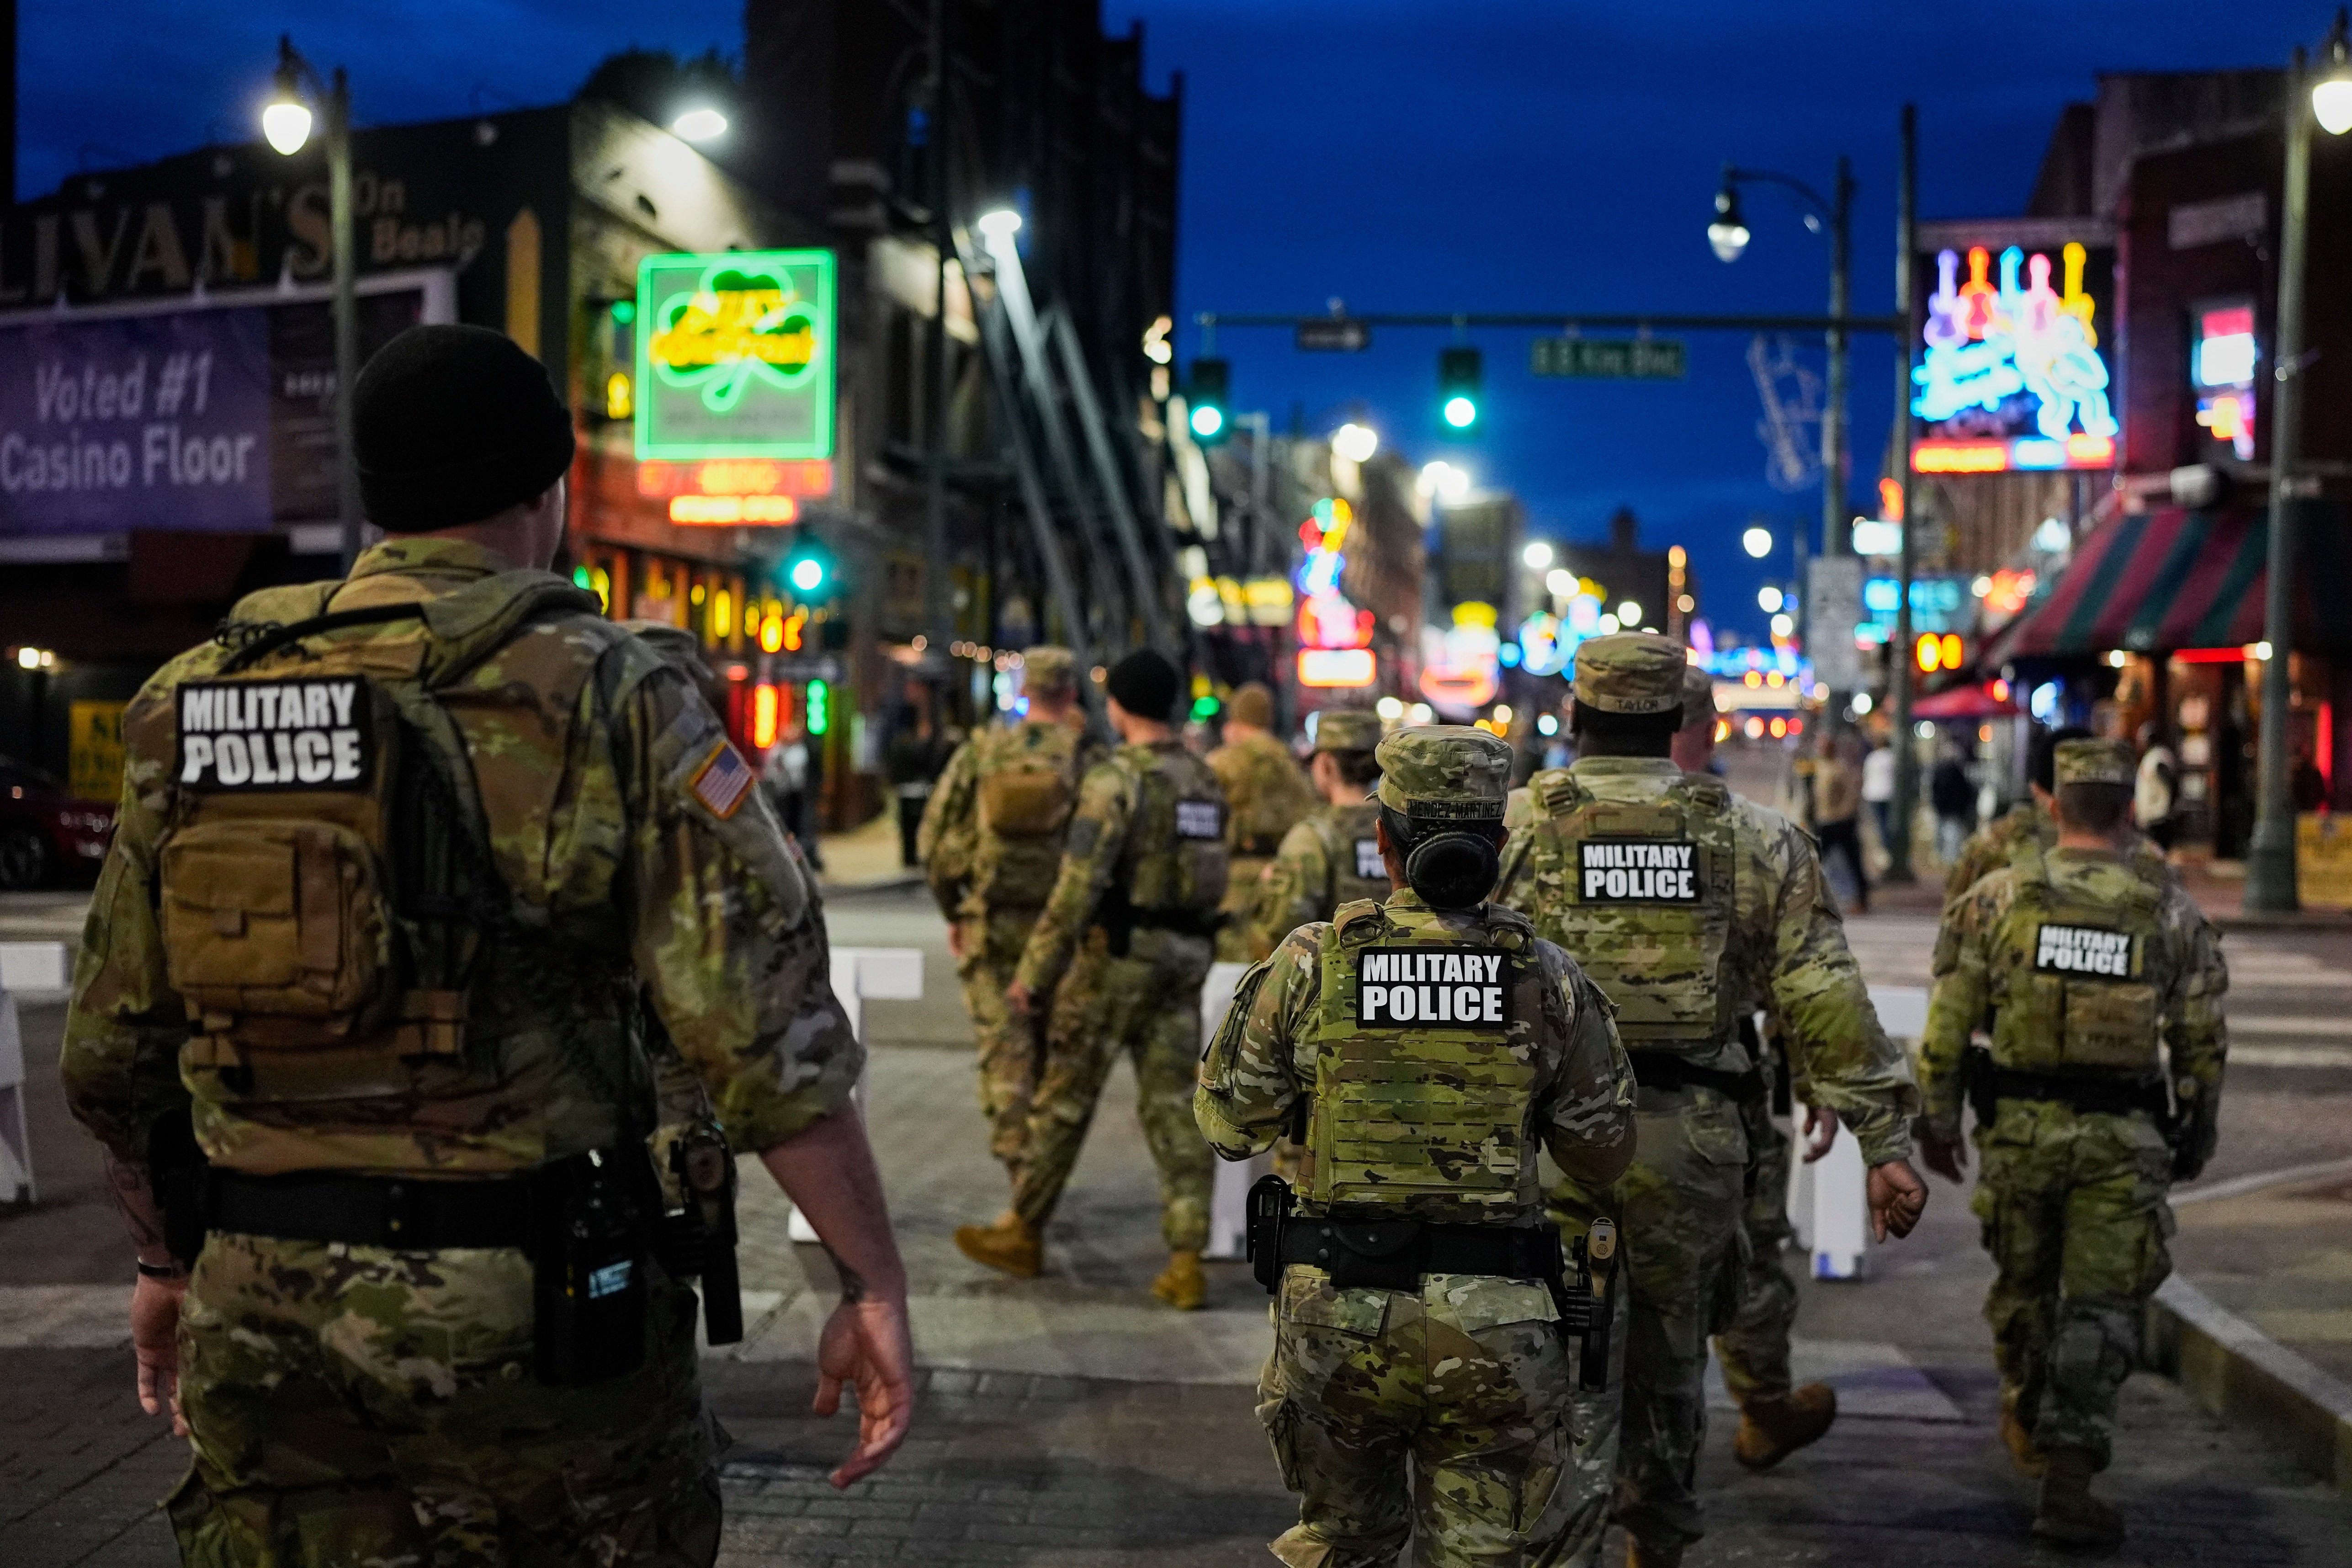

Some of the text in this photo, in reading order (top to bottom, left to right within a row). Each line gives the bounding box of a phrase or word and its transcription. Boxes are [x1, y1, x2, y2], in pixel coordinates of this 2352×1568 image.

[36, 351, 213, 422] Voted #1
[0, 423, 256, 493] Casino Floor
[183, 683, 356, 731] MILITARY
[1617, 699, 1659, 710] TAYLOR
[181, 729, 361, 786] POLICE
[1583, 845, 1691, 868] MILITARY
[1585, 869, 1695, 898] POLICE
[2040, 925, 2130, 953] MILITARY
[1363, 954, 1502, 982] MILITARY
[2037, 945, 2128, 976] POLICE
[1363, 985, 1503, 1021] POLICE
